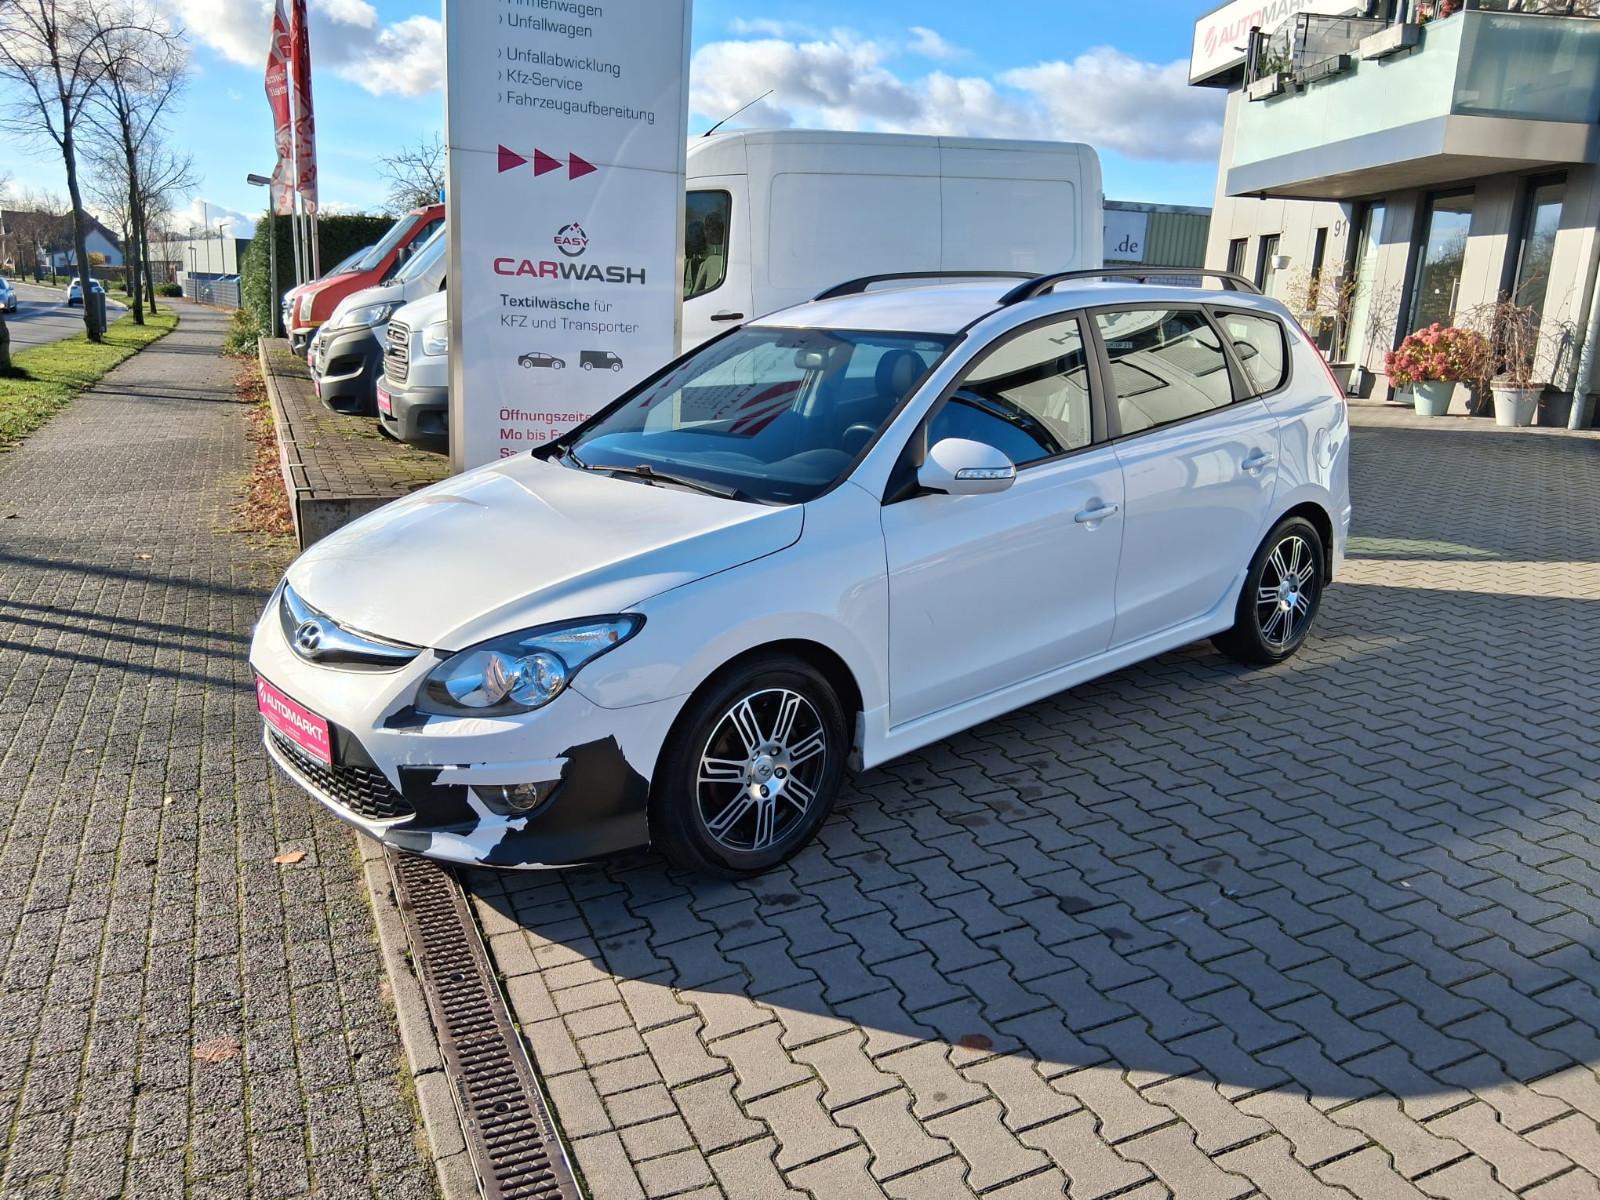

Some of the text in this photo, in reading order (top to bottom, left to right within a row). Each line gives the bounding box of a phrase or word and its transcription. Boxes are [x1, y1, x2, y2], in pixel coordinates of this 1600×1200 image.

[508, 13, 592, 39] Unfallwagen
[1218, 0, 1313, 47] AUTOMAR
[507, 47, 621, 78] Unfallabwicklung
[507, 69, 583, 91] Kfz-Service
[507, 91, 655, 125] Fahrzeugaufbereitung
[1334, 219, 1347, 238] 91
[553, 235, 590, 247] EASY
[1113, 234, 1139, 253] .de
[493, 257, 646, 285] CARWASH
[500, 294, 613, 313] Textilwäsche für
[500, 314, 640, 335] KFZ und Transporter
[500, 406, 593, 425] Öffnungszeite
[500, 428, 523, 441] Mo
[527, 429, 546, 441] bis
[267, 693, 323, 740] AUTOMARKT
